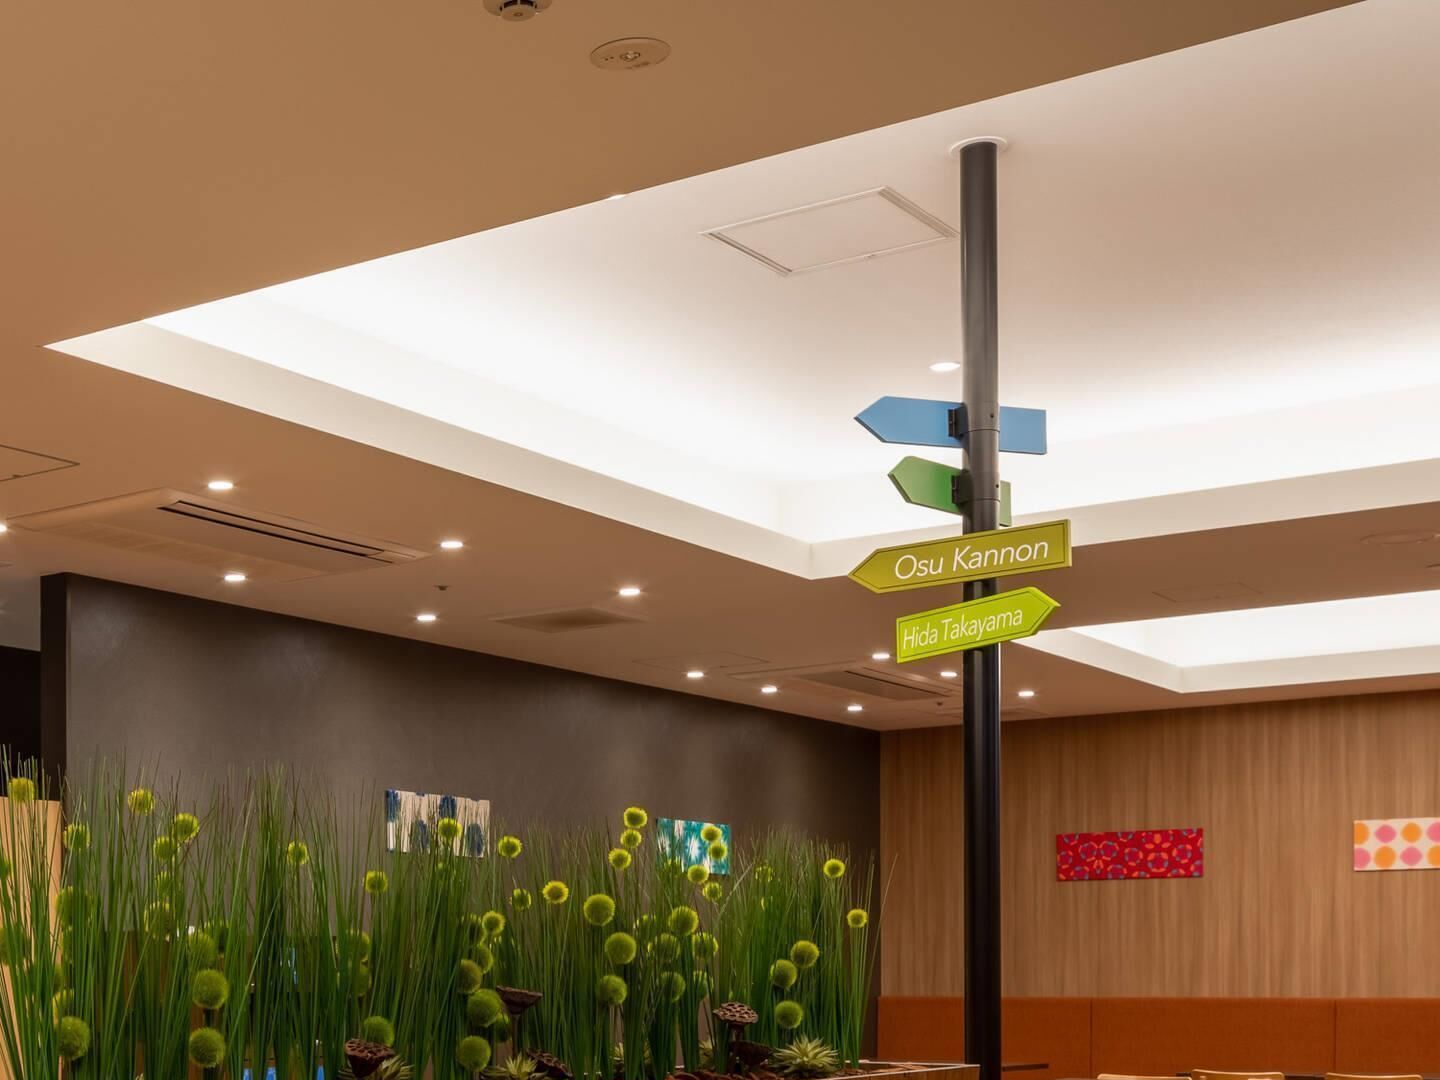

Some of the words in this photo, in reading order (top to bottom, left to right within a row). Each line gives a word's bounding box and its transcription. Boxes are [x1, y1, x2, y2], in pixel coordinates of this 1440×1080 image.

[894, 554, 944, 580] Osu
[952, 540, 1049, 573] Kannon
[903, 621, 938, 650] Hida
[942, 608, 1023, 642] Takayama
